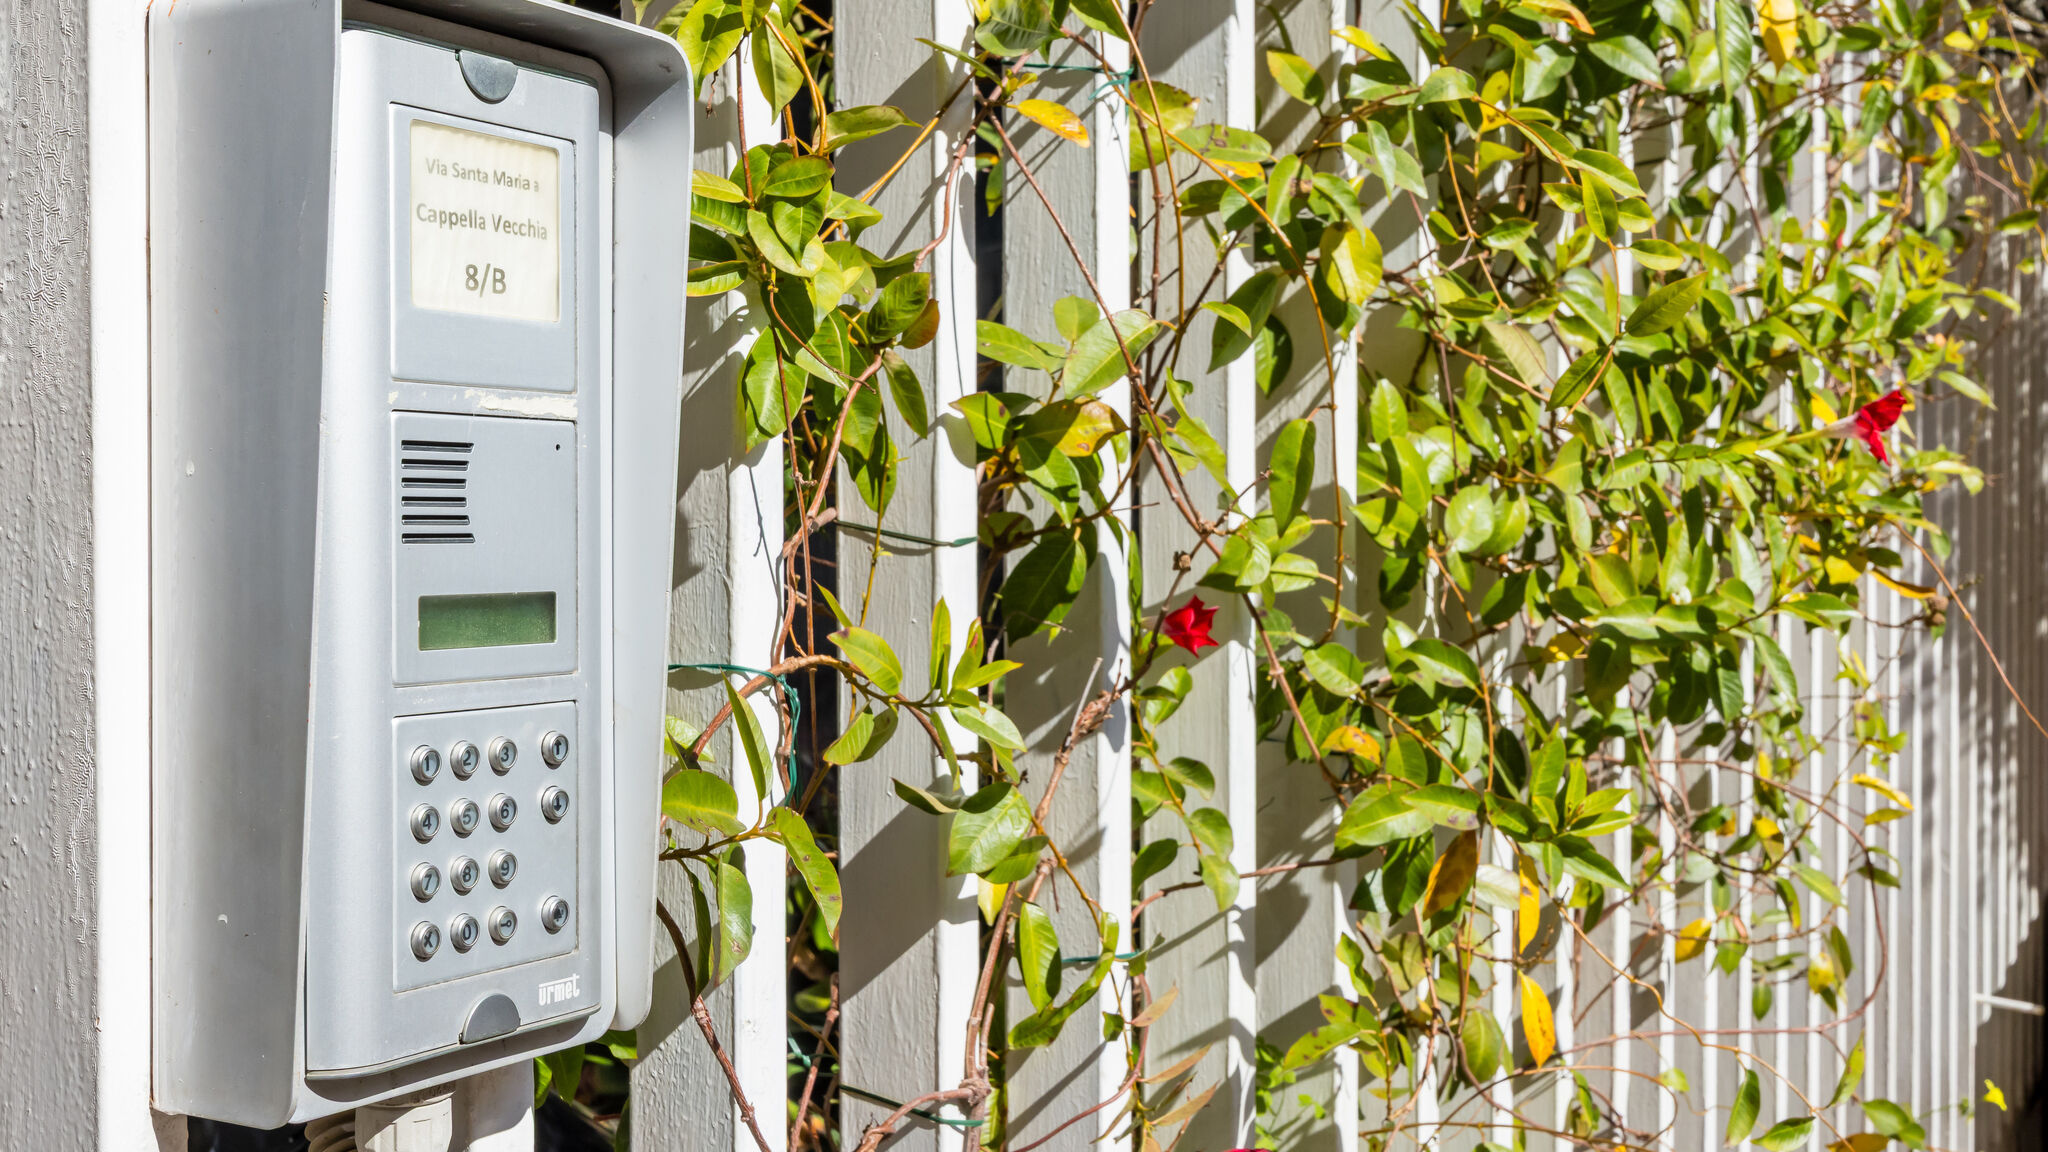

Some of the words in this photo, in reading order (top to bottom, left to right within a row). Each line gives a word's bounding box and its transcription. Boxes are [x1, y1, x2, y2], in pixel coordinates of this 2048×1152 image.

[425, 157, 448, 177] Via
[452, 162, 489, 184] Santa
[493, 169, 531, 191] Maria
[533, 180, 540, 193] a
[416, 202, 486, 231] Cappella
[491, 213, 548, 241] Vecchia
[465, 262, 507, 298] 8/B
[462, 750, 472, 766] 2
[501, 746, 509, 762] 3
[422, 814, 432, 830] 4
[462, 809, 472, 825] 5
[501, 803, 509, 819] 6
[424, 874, 432, 890] 7
[462, 866, 472, 882] 8
[501, 861, 510, 877] 9
[463, 925, 472, 940] 0
[538, 973, 580, 1006] urmet
